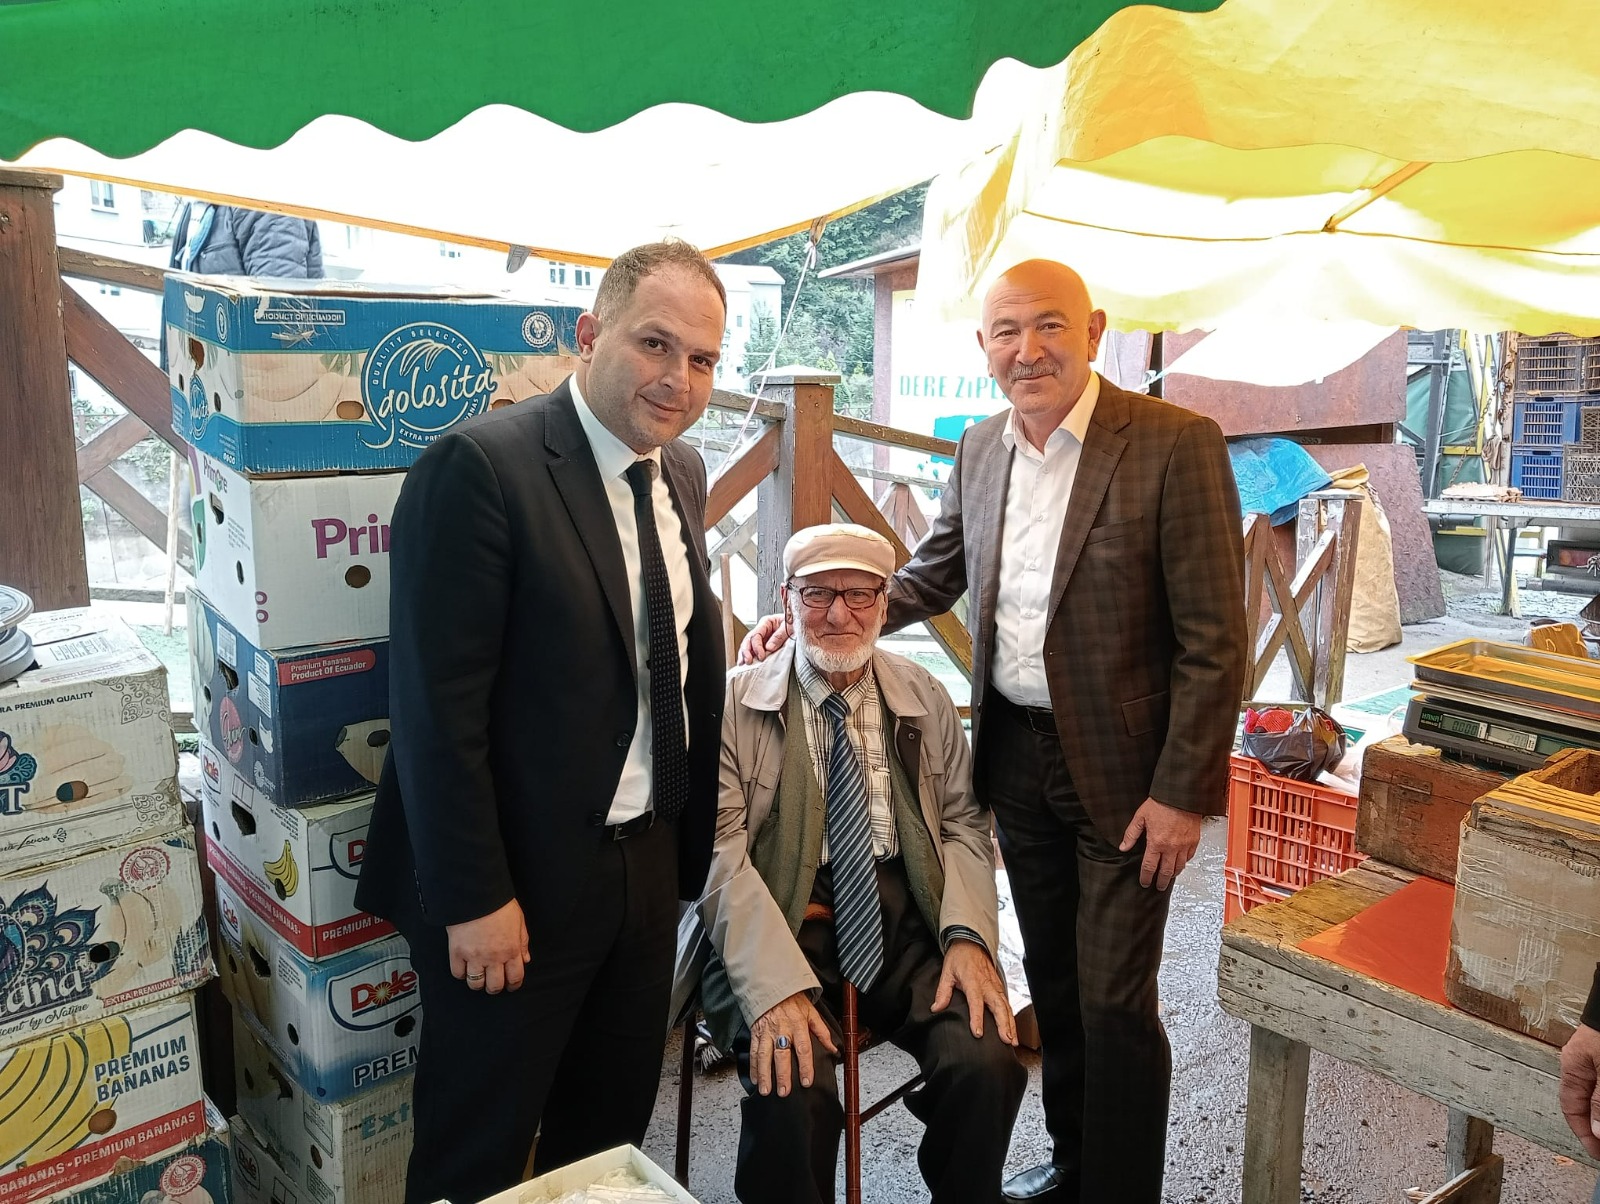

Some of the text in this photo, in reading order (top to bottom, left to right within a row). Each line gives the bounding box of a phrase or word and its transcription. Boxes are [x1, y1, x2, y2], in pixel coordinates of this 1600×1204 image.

[260, 311, 294, 321] RODUCT
[372, 328, 469, 386] QUALITY SELECTED
[899, 375, 948, 397] DERE
[361, 363, 497, 450] golosita
[398, 428, 423, 442] EXTRA
[291, 656, 351, 673] Premium Bananas
[291, 661, 367, 681] Product Of Ecuador
[14, 699, 55, 712] PREMIUM
[56, 690, 94, 703] QUALITY
[322, 916, 372, 942] PREMIUM
[0, 969, 88, 1018] ana
[106, 992, 133, 1007] EXTRA
[134, 981, 171, 998] PREMIUM
[350, 969, 418, 1012] Dole
[45, 1003, 89, 1025] Nature
[94, 1035, 188, 1082] PREMIUM
[97, 1055, 191, 1103] BANANAS
[0, 1162, 66, 1195] BANANAS
[74, 1135, 136, 1168] PREMIUM
[138, 1111, 197, 1144] BANANAS
